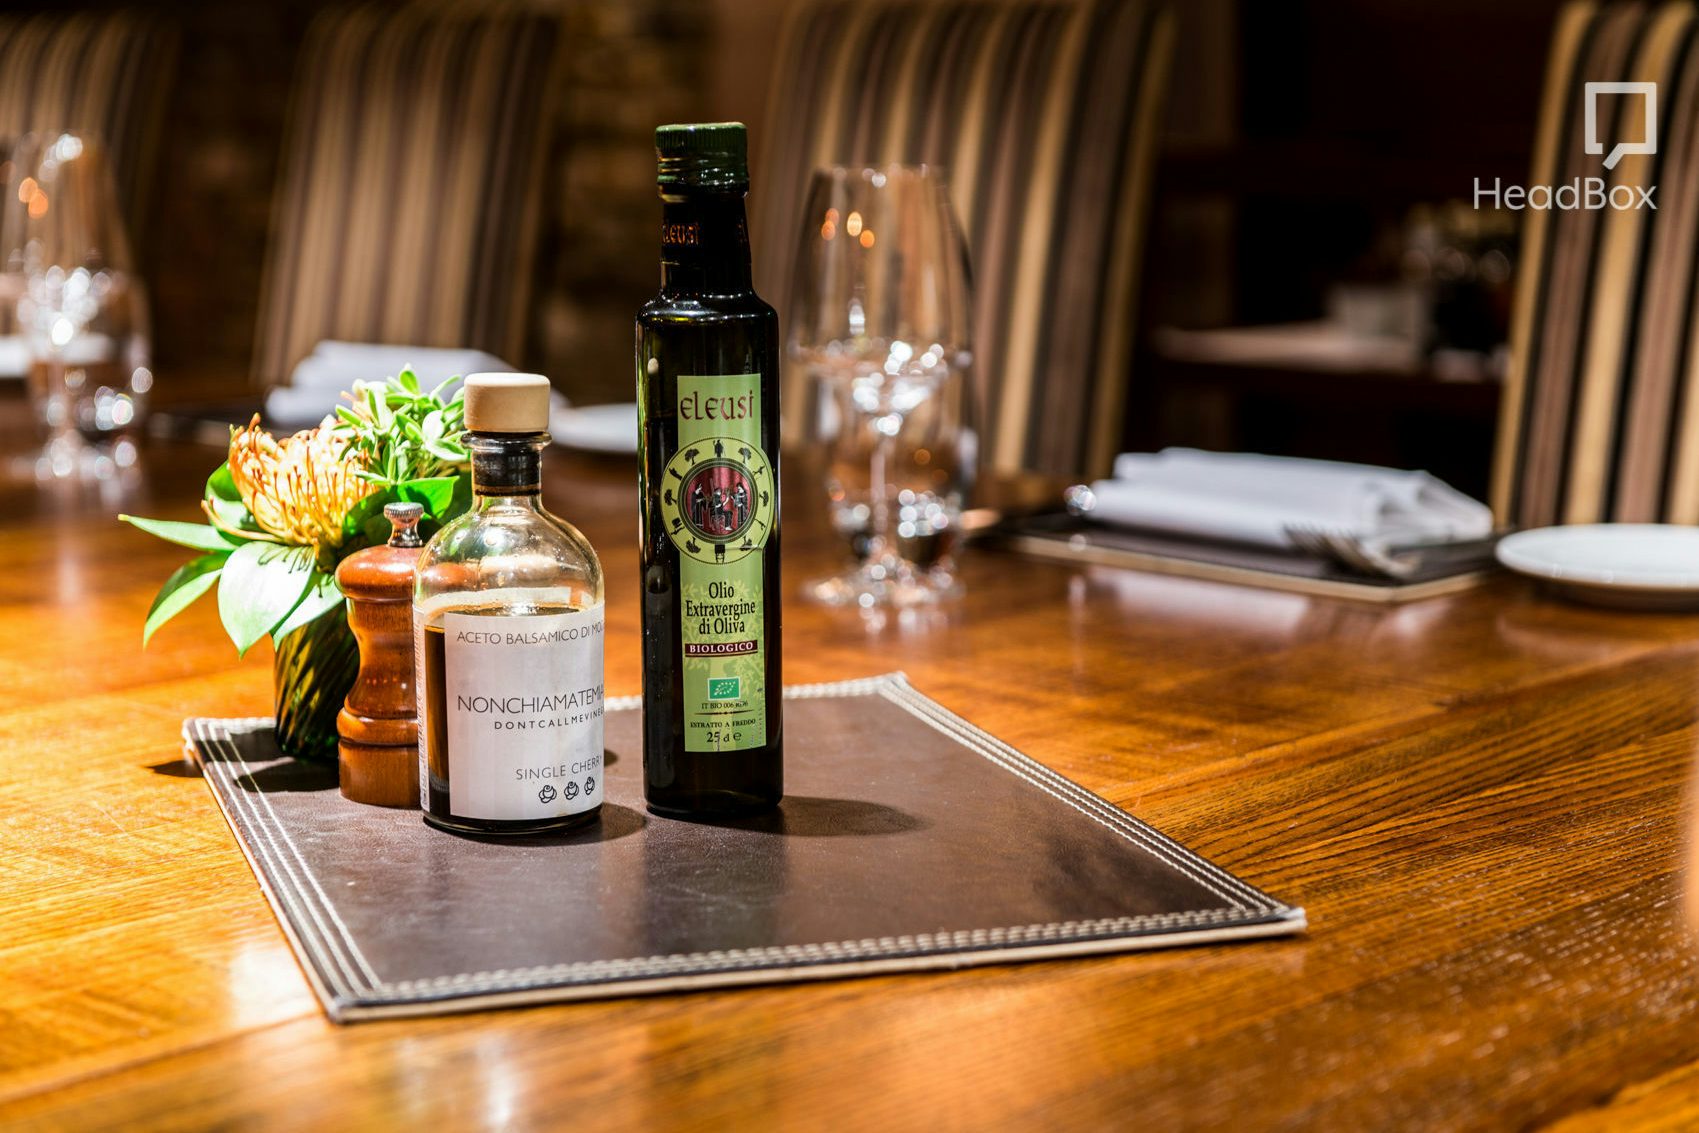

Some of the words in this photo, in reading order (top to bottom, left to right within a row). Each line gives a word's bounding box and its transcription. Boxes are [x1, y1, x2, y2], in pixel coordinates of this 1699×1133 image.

[680, 389, 754, 420] eleusi
[708, 581, 735, 599] Olio
[686, 598, 756, 620] Extravergine
[456, 631, 502, 645] ACETO
[506, 628, 579, 645] BALSAMICO
[580, 625, 590, 638] DI
[698, 618, 711, 635] di
[713, 617, 745, 634] Oliva
[689, 641, 754, 654] BIOLOGICO
[516, 765, 567, 781] SINGLE
